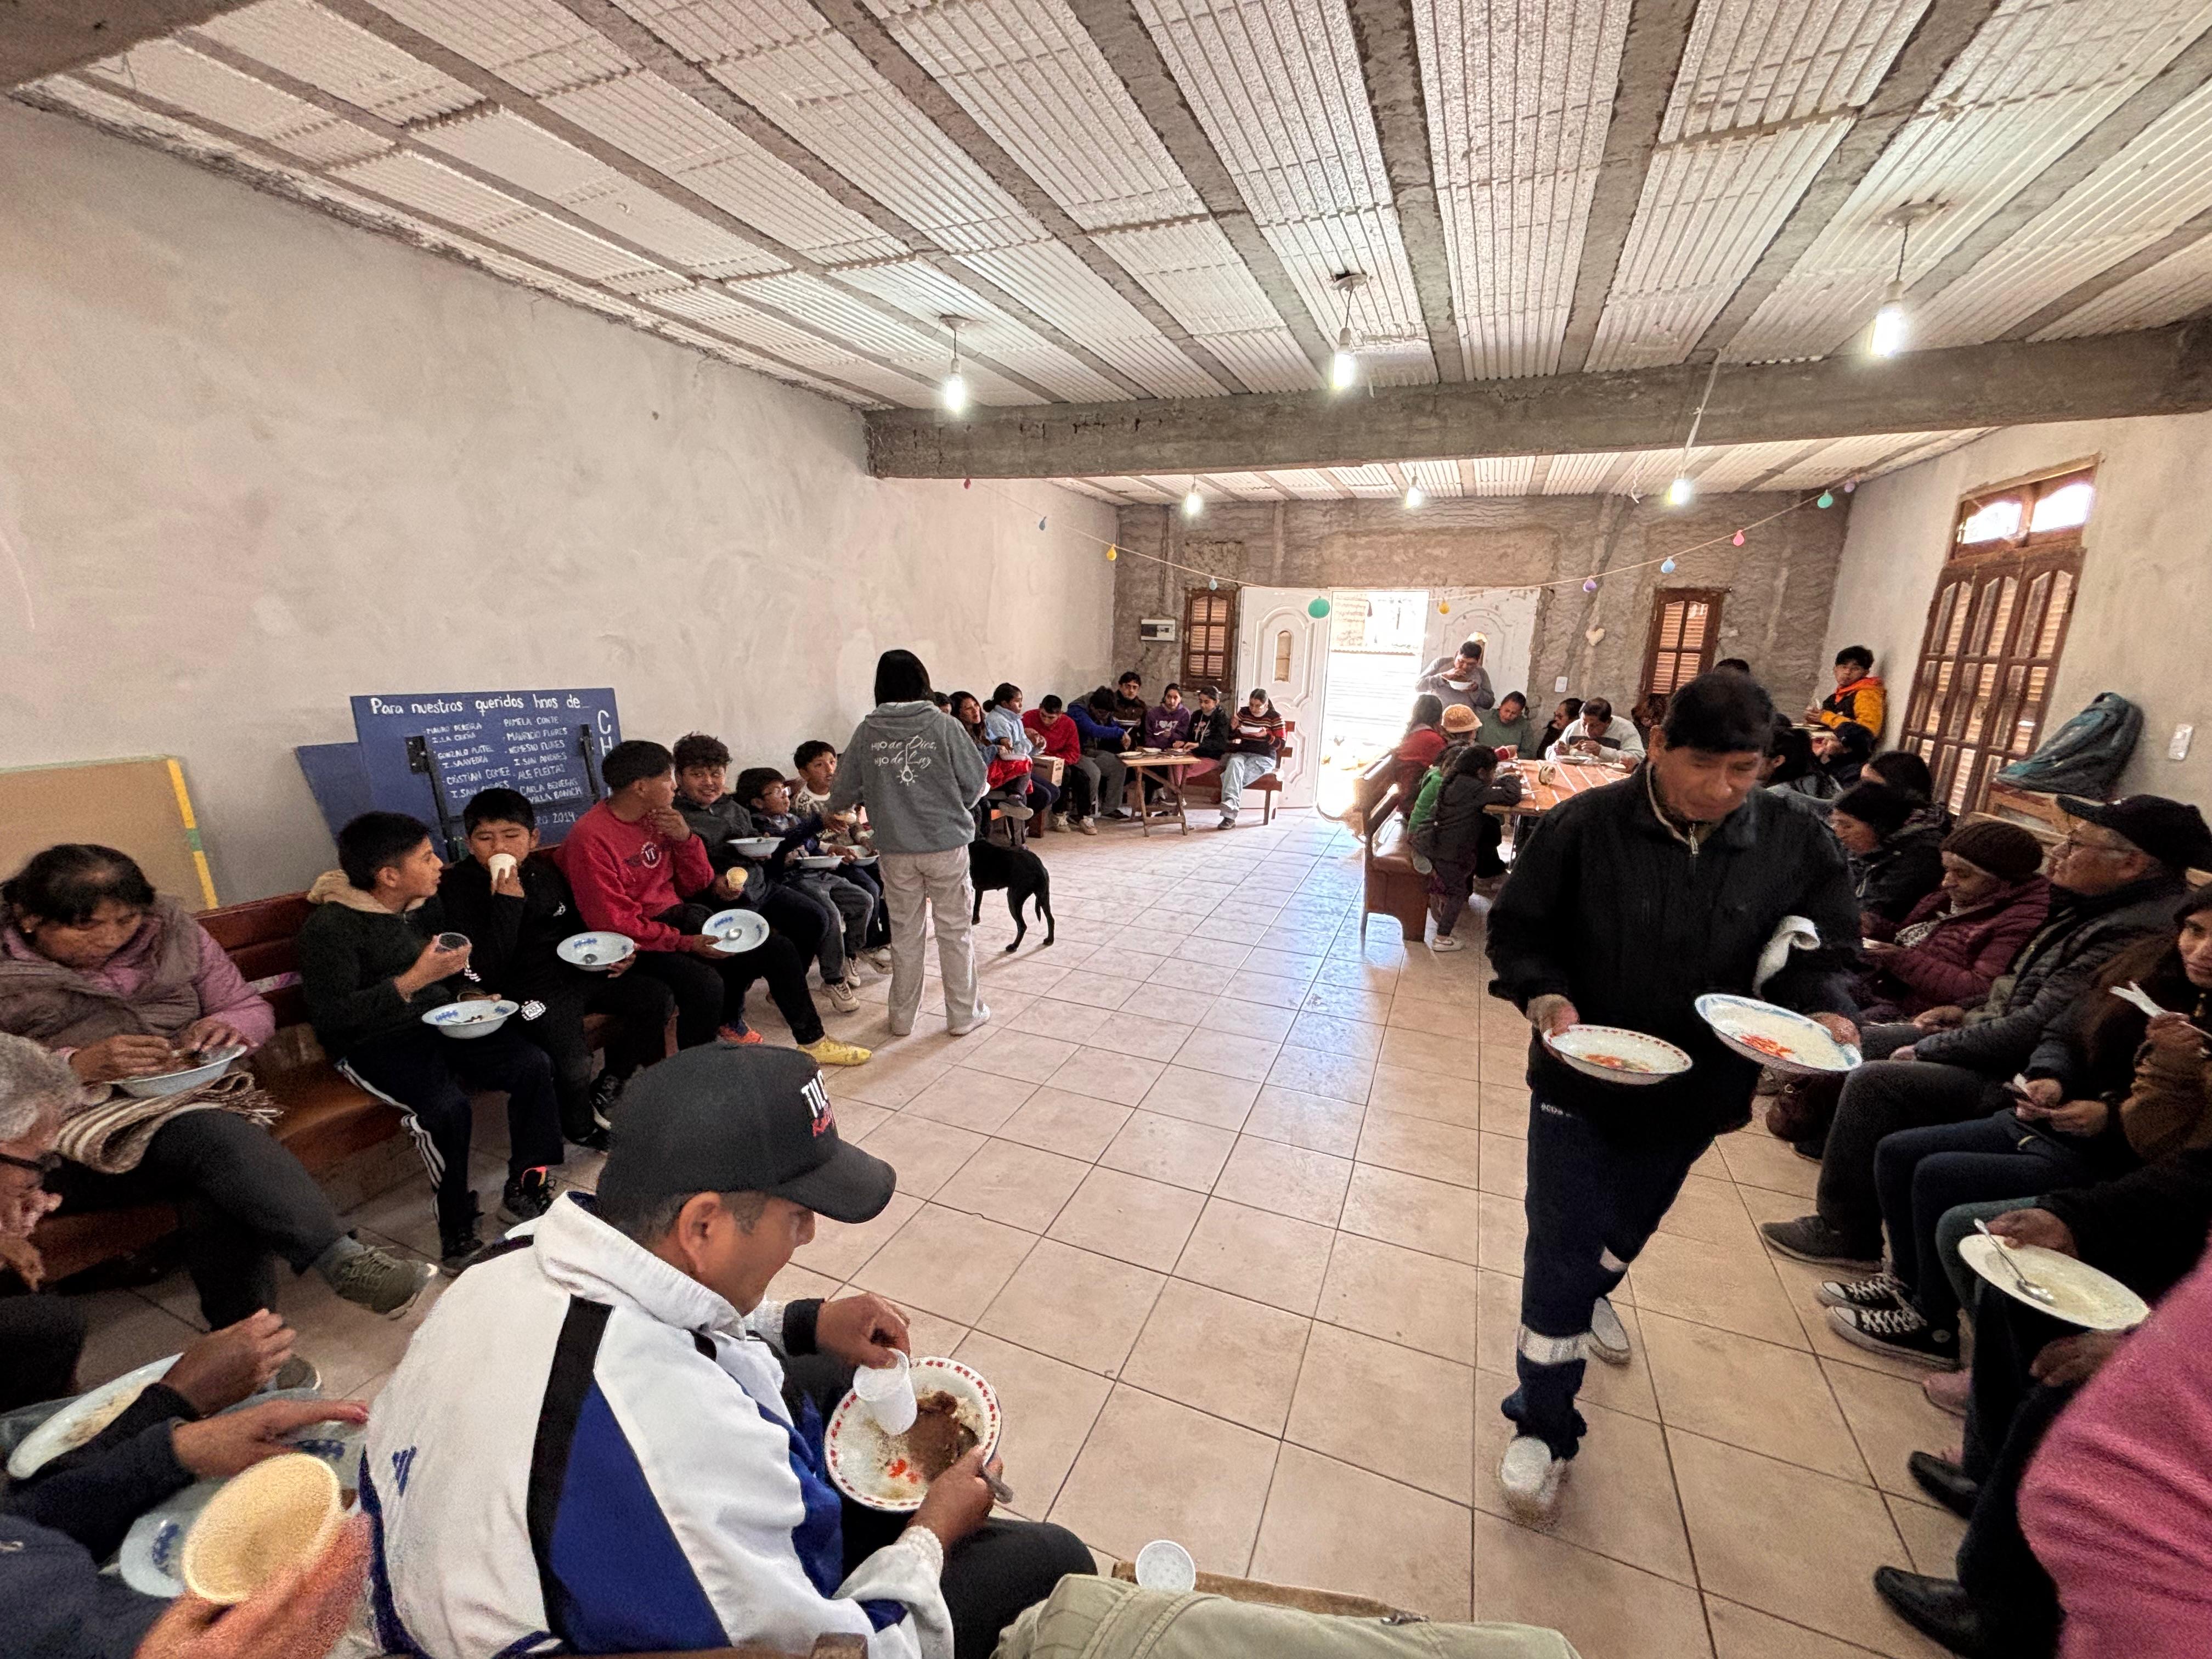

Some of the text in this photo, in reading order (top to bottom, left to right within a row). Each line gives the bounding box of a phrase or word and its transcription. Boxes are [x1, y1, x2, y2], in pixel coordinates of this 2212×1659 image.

[370, 697, 404, 714] Para
[411, 699, 463, 714] nuestros
[475, 694, 524, 717] queridos
[533, 693, 558, 709] hnos
